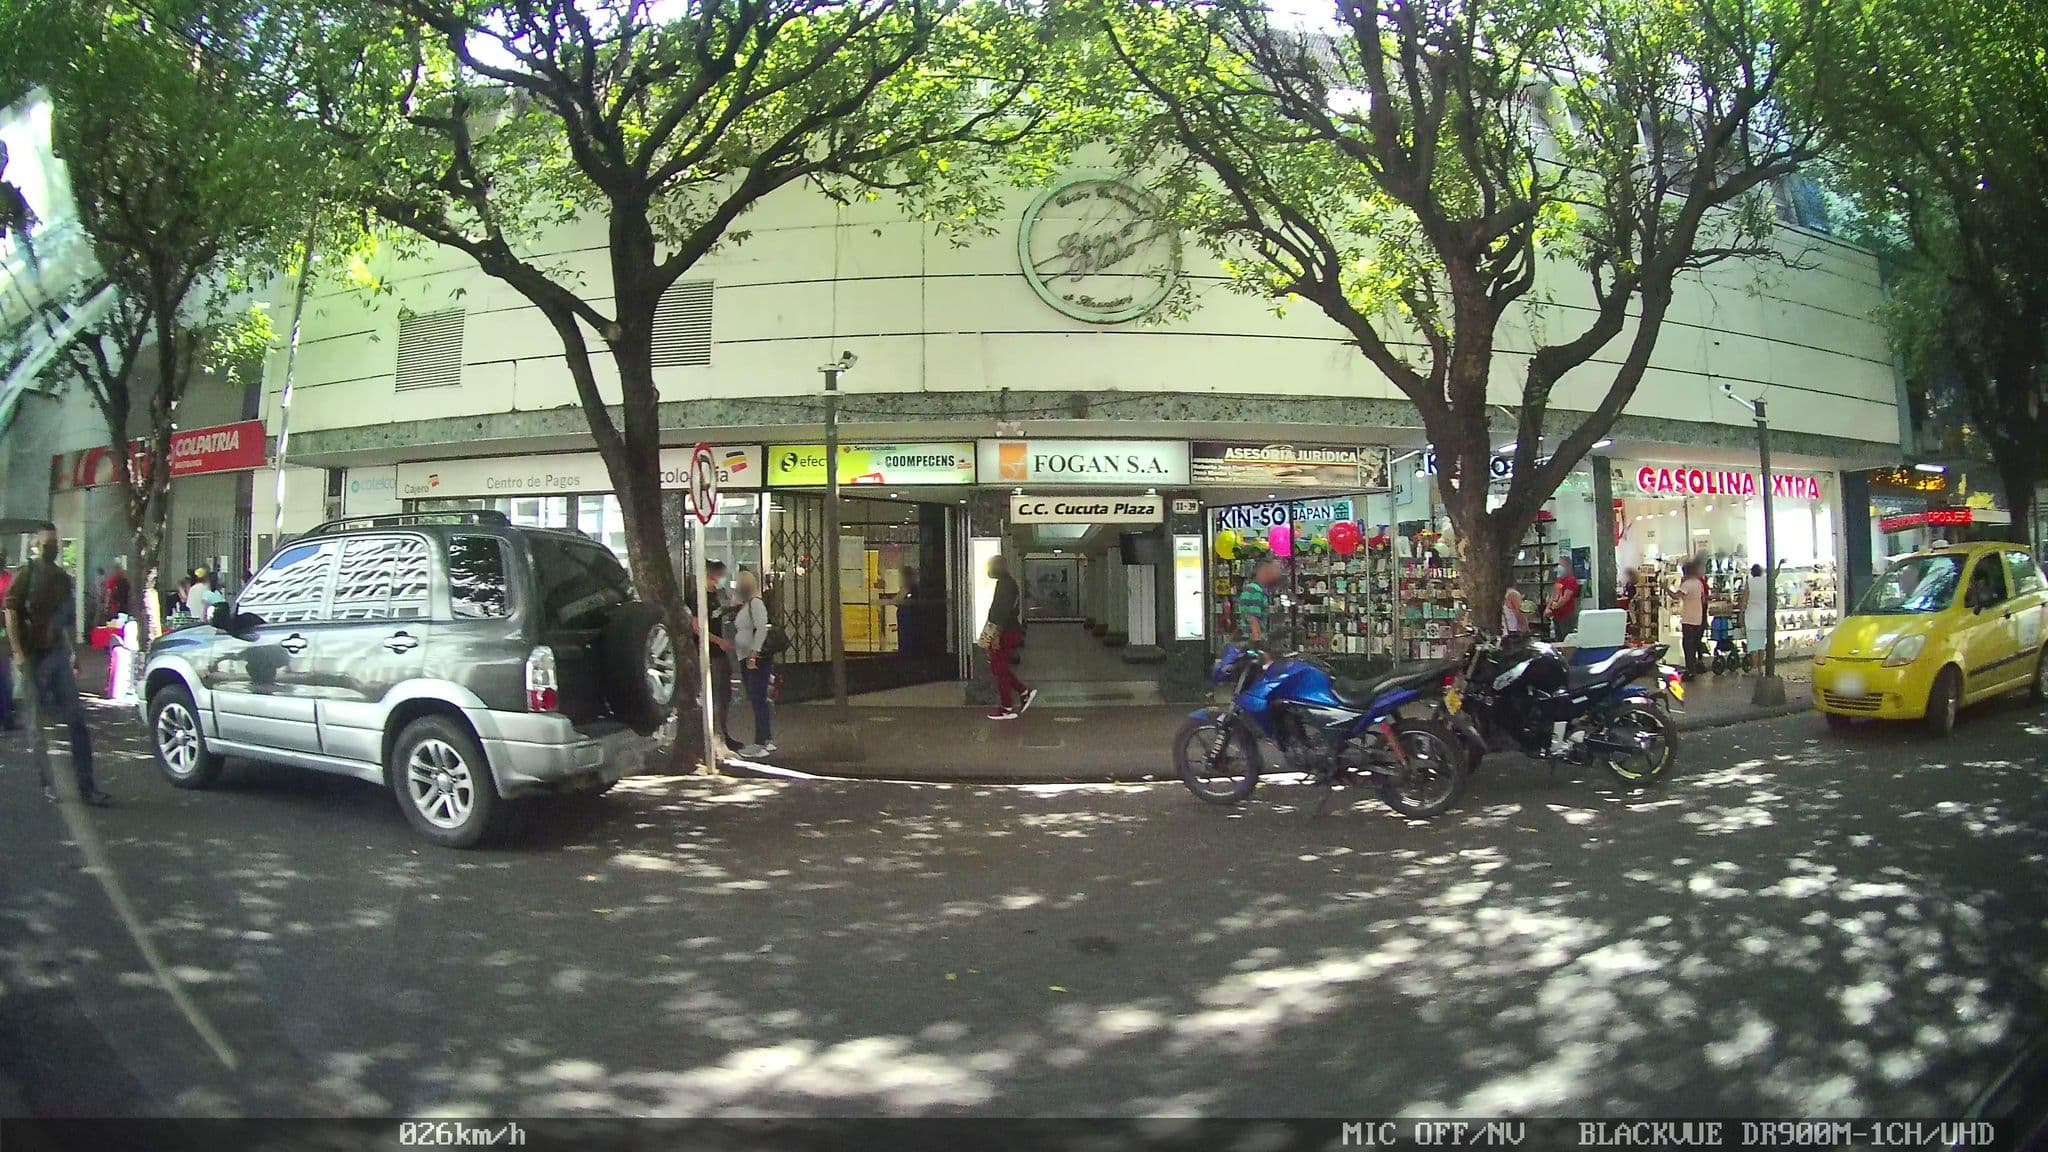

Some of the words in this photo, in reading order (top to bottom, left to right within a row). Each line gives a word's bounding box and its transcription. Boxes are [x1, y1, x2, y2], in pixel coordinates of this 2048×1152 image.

[174, 430, 239, 457] COLPATRIA
[799, 455, 828, 468] efec
[884, 455, 955, 468] COOMPECENS
[1296, 448, 1357, 463] JURÍDICA
[1034, 454, 1120, 473] FOGAN
[1126, 455, 1169, 474] S.A.
[486, 476, 523, 489] Centro
[527, 474, 541, 488] de
[545, 473, 580, 489] Pagos
[1637, 465, 1757, 497] GASOLINA
[1759, 472, 1821, 500] XTRA
[404, 483, 430, 496] Cajero
[1018, 502, 1049, 516] C.C.
[1054, 502, 1108, 516] Cucuta
[1113, 502, 1155, 516] Plaza
[1220, 505, 1286, 528] KIN-SO
